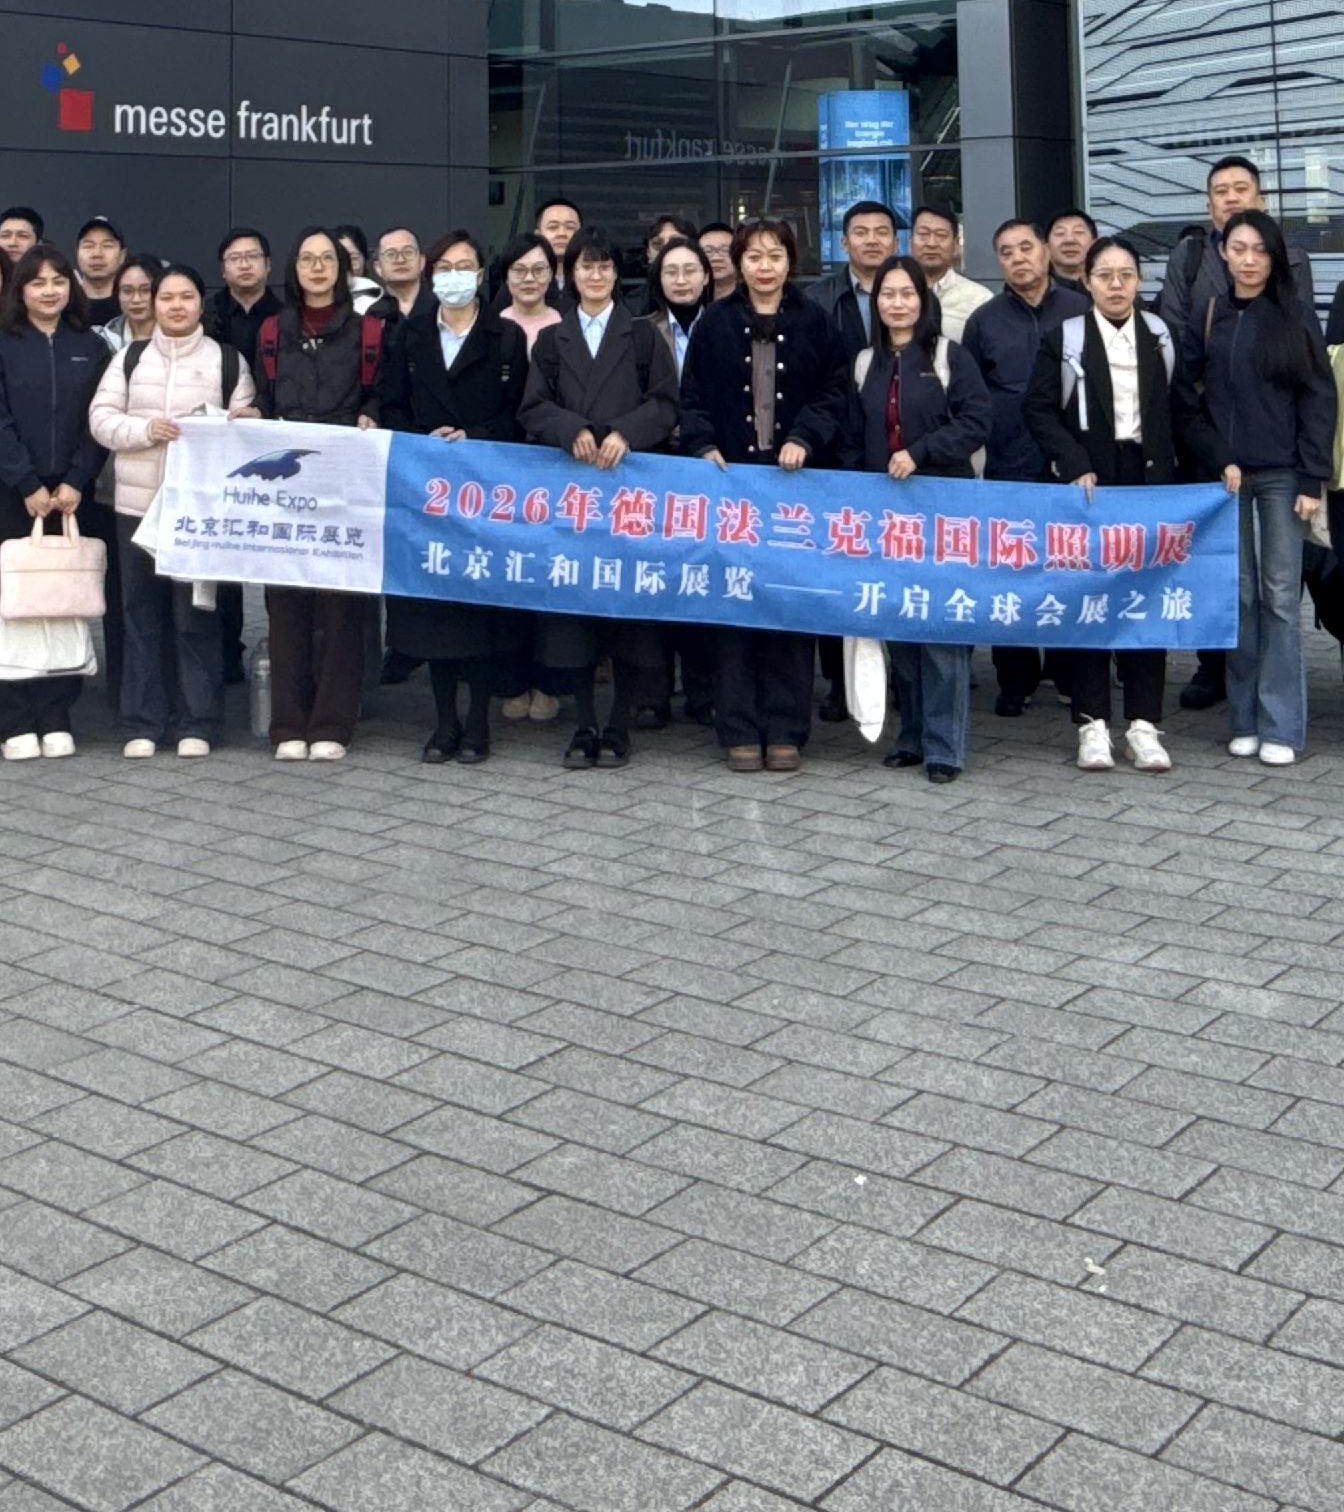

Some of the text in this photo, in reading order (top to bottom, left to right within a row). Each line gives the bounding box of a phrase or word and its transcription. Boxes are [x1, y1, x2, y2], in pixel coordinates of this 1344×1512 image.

[114, 99, 373, 145] messe frankfurt
[223, 486, 318, 513] Huihe Expo
[174, 516, 365, 548] 北京汇和国际展览
[423, 477, 1196, 573] 2026年德国法兰克福国际照明展
